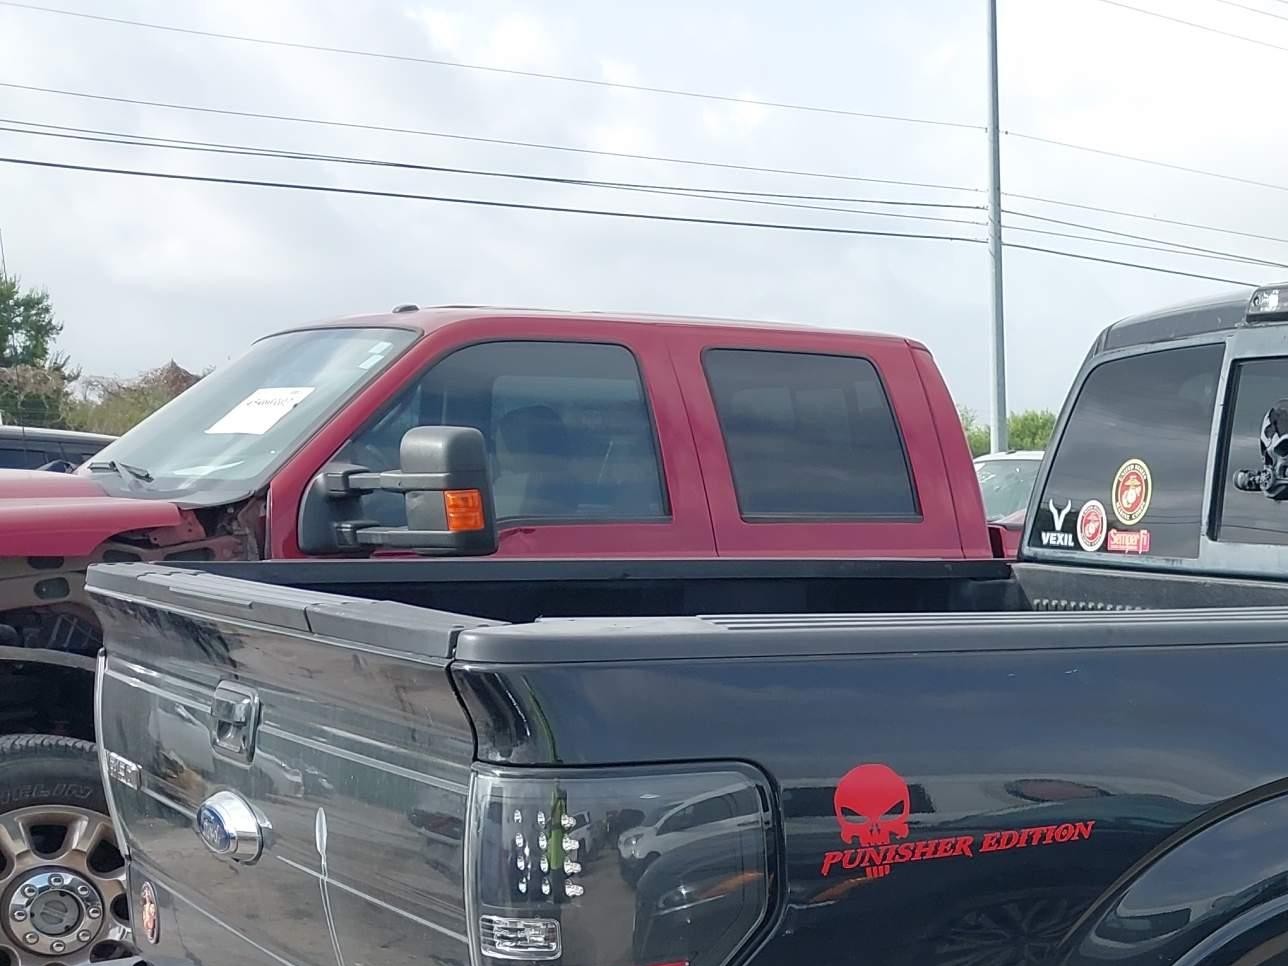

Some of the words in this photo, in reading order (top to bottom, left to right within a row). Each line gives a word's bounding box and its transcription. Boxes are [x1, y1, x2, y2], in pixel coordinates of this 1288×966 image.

[1041, 531, 1074, 547] VEXIL
[820, 835, 974, 875] PUNISHER
[979, 820, 1096, 852] EDITION
